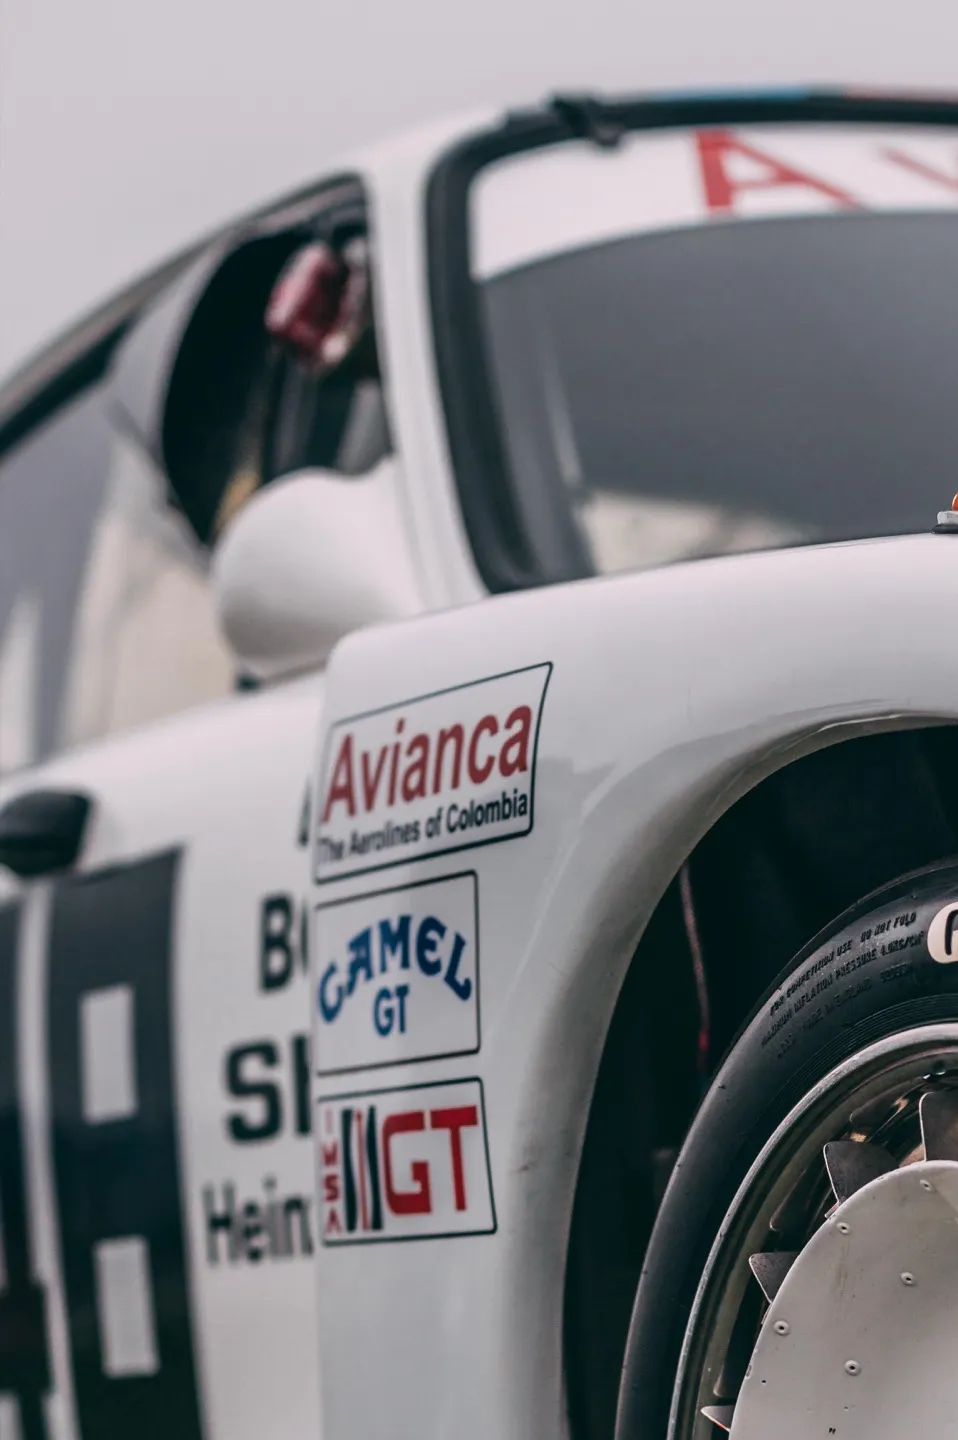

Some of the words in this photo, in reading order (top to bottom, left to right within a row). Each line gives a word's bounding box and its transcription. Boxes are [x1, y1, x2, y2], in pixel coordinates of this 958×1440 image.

[321, 705, 532, 825] Avianca
[425, 807, 443, 839] of
[446, 789, 528, 834] Colombia
[317, 914, 473, 1024] CAMEL
[373, 984, 410, 1037] GT
[382, 1105, 478, 1217] GT
